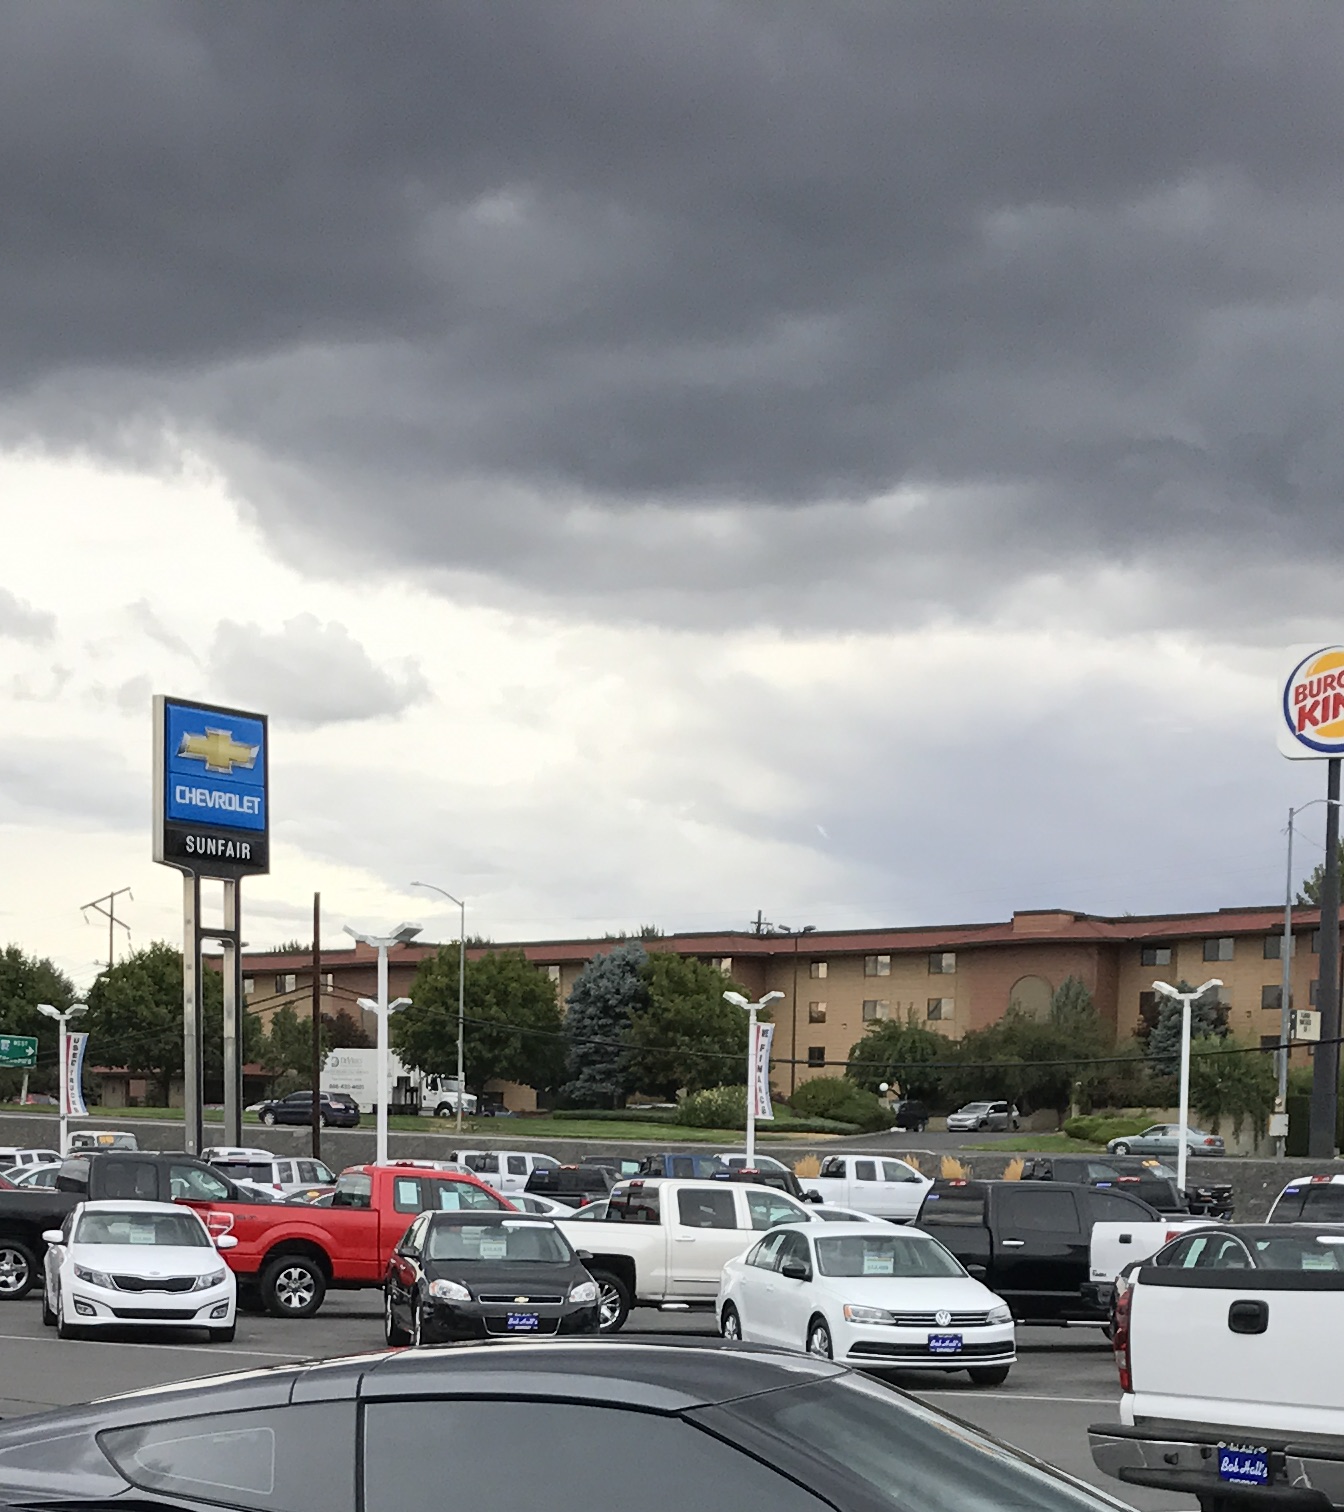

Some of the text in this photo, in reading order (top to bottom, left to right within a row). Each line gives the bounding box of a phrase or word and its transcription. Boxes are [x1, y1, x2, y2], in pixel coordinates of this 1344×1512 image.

[175, 785, 261, 815] CHEVROLET
[185, 835, 251, 860] SUNFAIR
[1220, 1457, 1268, 1478] Bob Hall's
